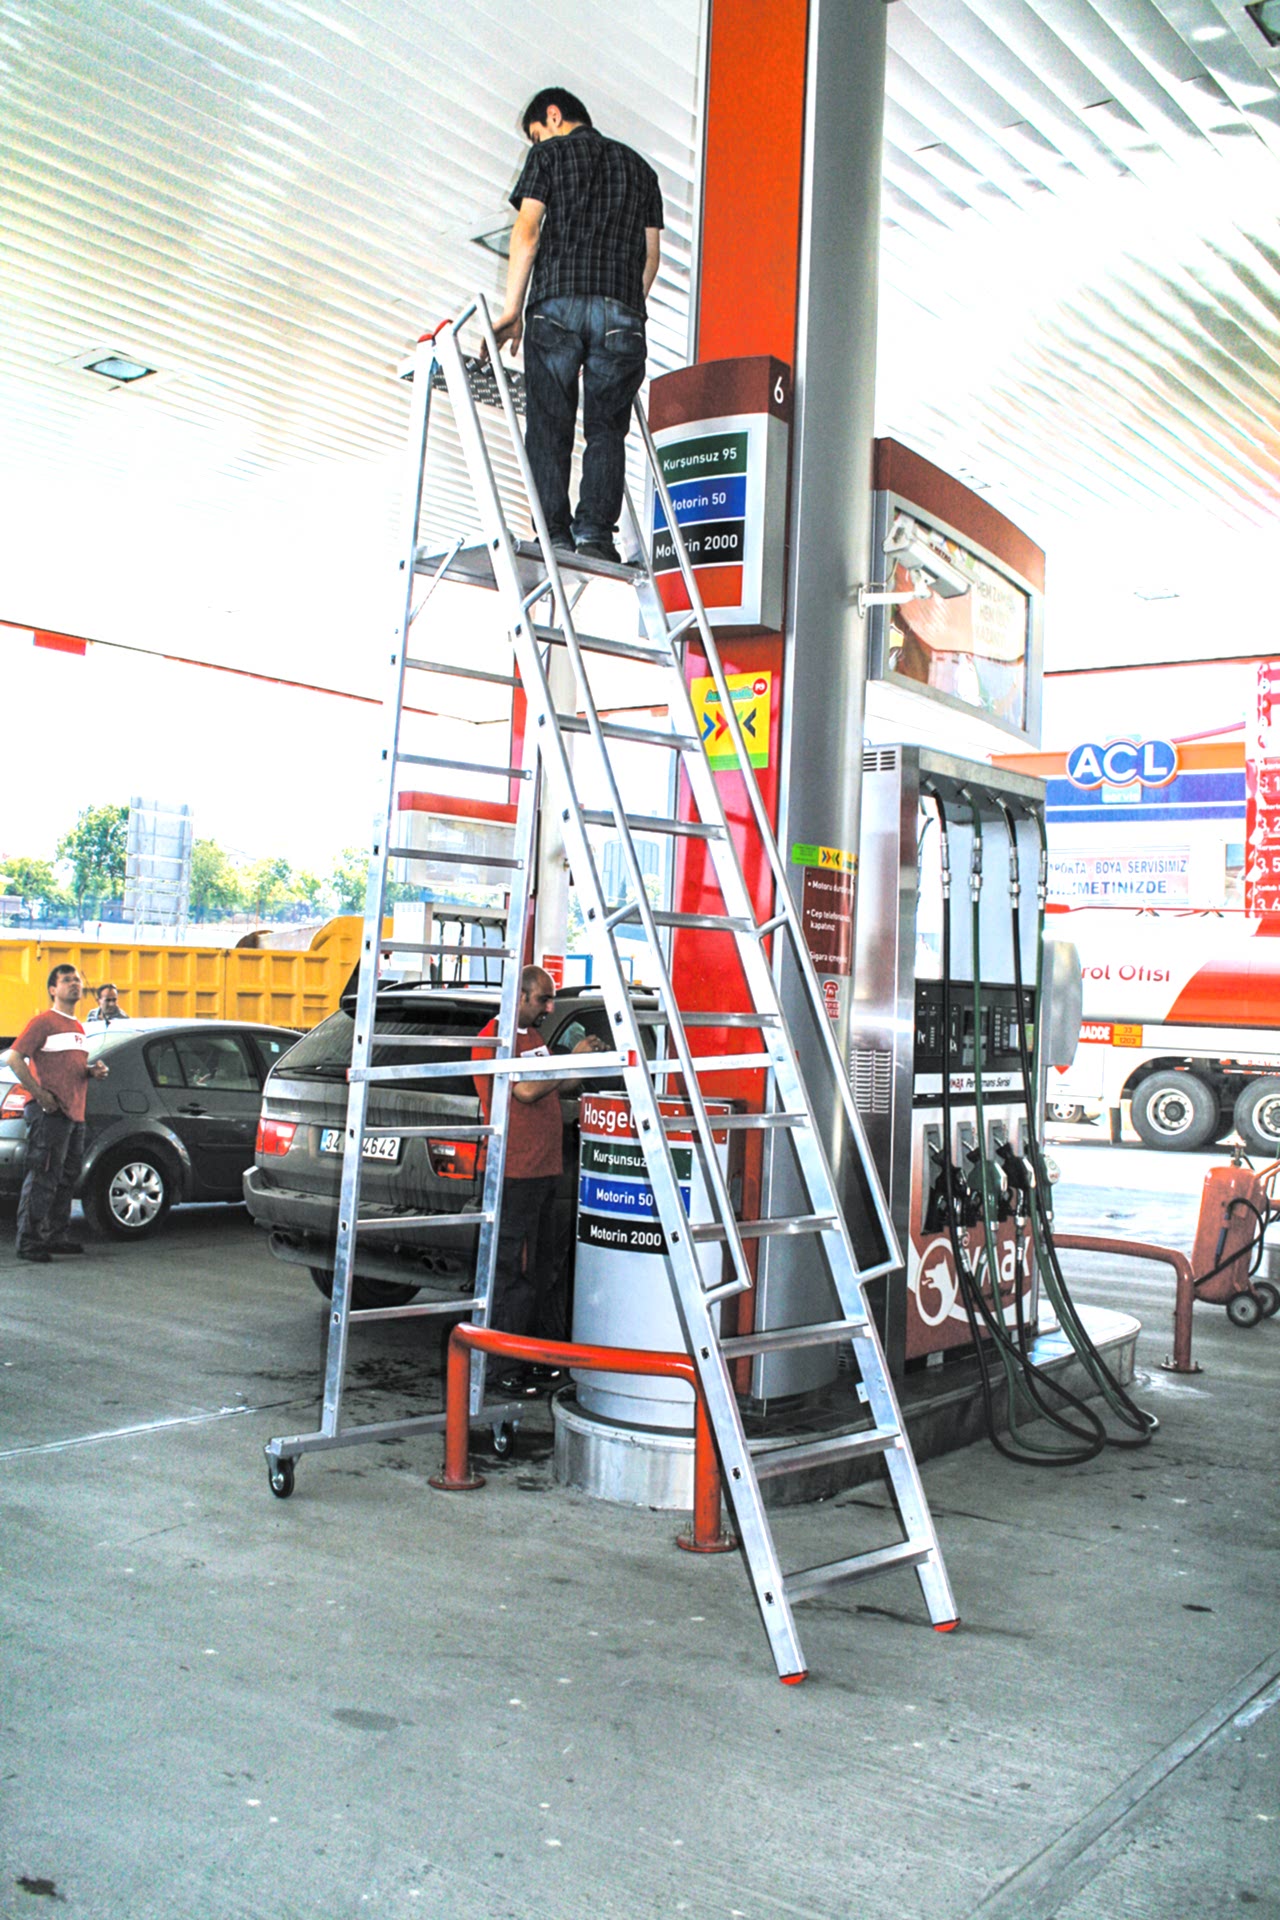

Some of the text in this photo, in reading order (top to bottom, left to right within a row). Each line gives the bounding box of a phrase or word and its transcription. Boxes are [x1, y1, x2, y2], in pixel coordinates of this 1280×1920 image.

[773, 376, 784, 404] 6
[663, 447, 738, 471] Kurşunsuz 95
[712, 492, 727, 505] 50
[704, 533, 738, 551] 2000
[1071, 743, 1169, 782] ACL
[1095, 861, 1122, 874] BOYA
[810, 908, 823, 920] Cep
[325, 1132, 397, 1157] 34 4642
[593, 1149, 648, 1168] Kurşunsuz
[596, 1187, 654, 1208] Motorin 50
[590, 1224, 662, 1247] Motorin 2000
